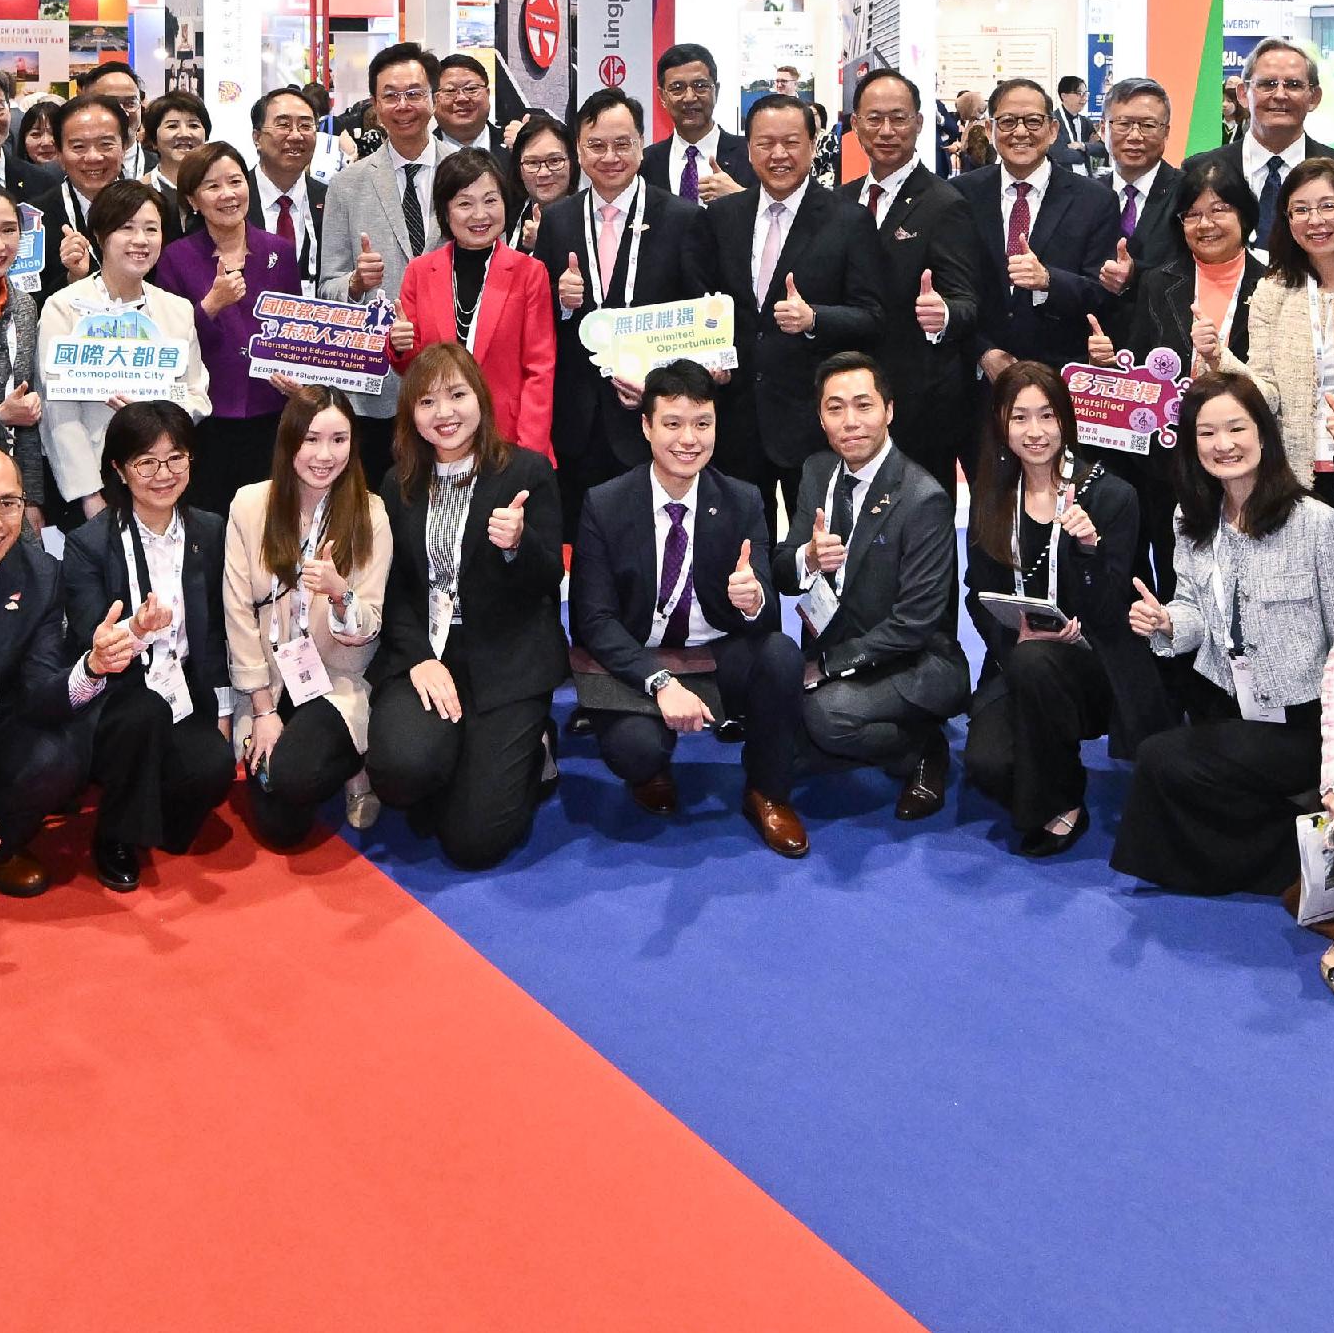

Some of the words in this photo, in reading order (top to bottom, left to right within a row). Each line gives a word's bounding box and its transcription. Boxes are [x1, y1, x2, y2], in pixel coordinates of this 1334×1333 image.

[260, 297, 366, 328] 國際教育樞紐
[278, 322, 387, 352] 未來人才搖籃
[646, 330, 695, 344] Unlimited
[657, 337, 727, 353] Opportunities
[54, 344, 179, 368] 國際大都會
[257, 339, 307, 354] International
[309, 346, 349, 359] Education
[350, 352, 366, 361] Hub
[368, 355, 383, 364] and
[274, 351, 300, 361] Cradle
[302, 355, 311, 363] of
[312, 356, 338, 366] Future
[340, 360, 365, 370] Talent
[67, 369, 141, 379] Cosmopolitan
[144, 370, 165, 381] City
[1068, 371, 1162, 405] 多元選擇
[1074, 408, 1108, 420] ptions
